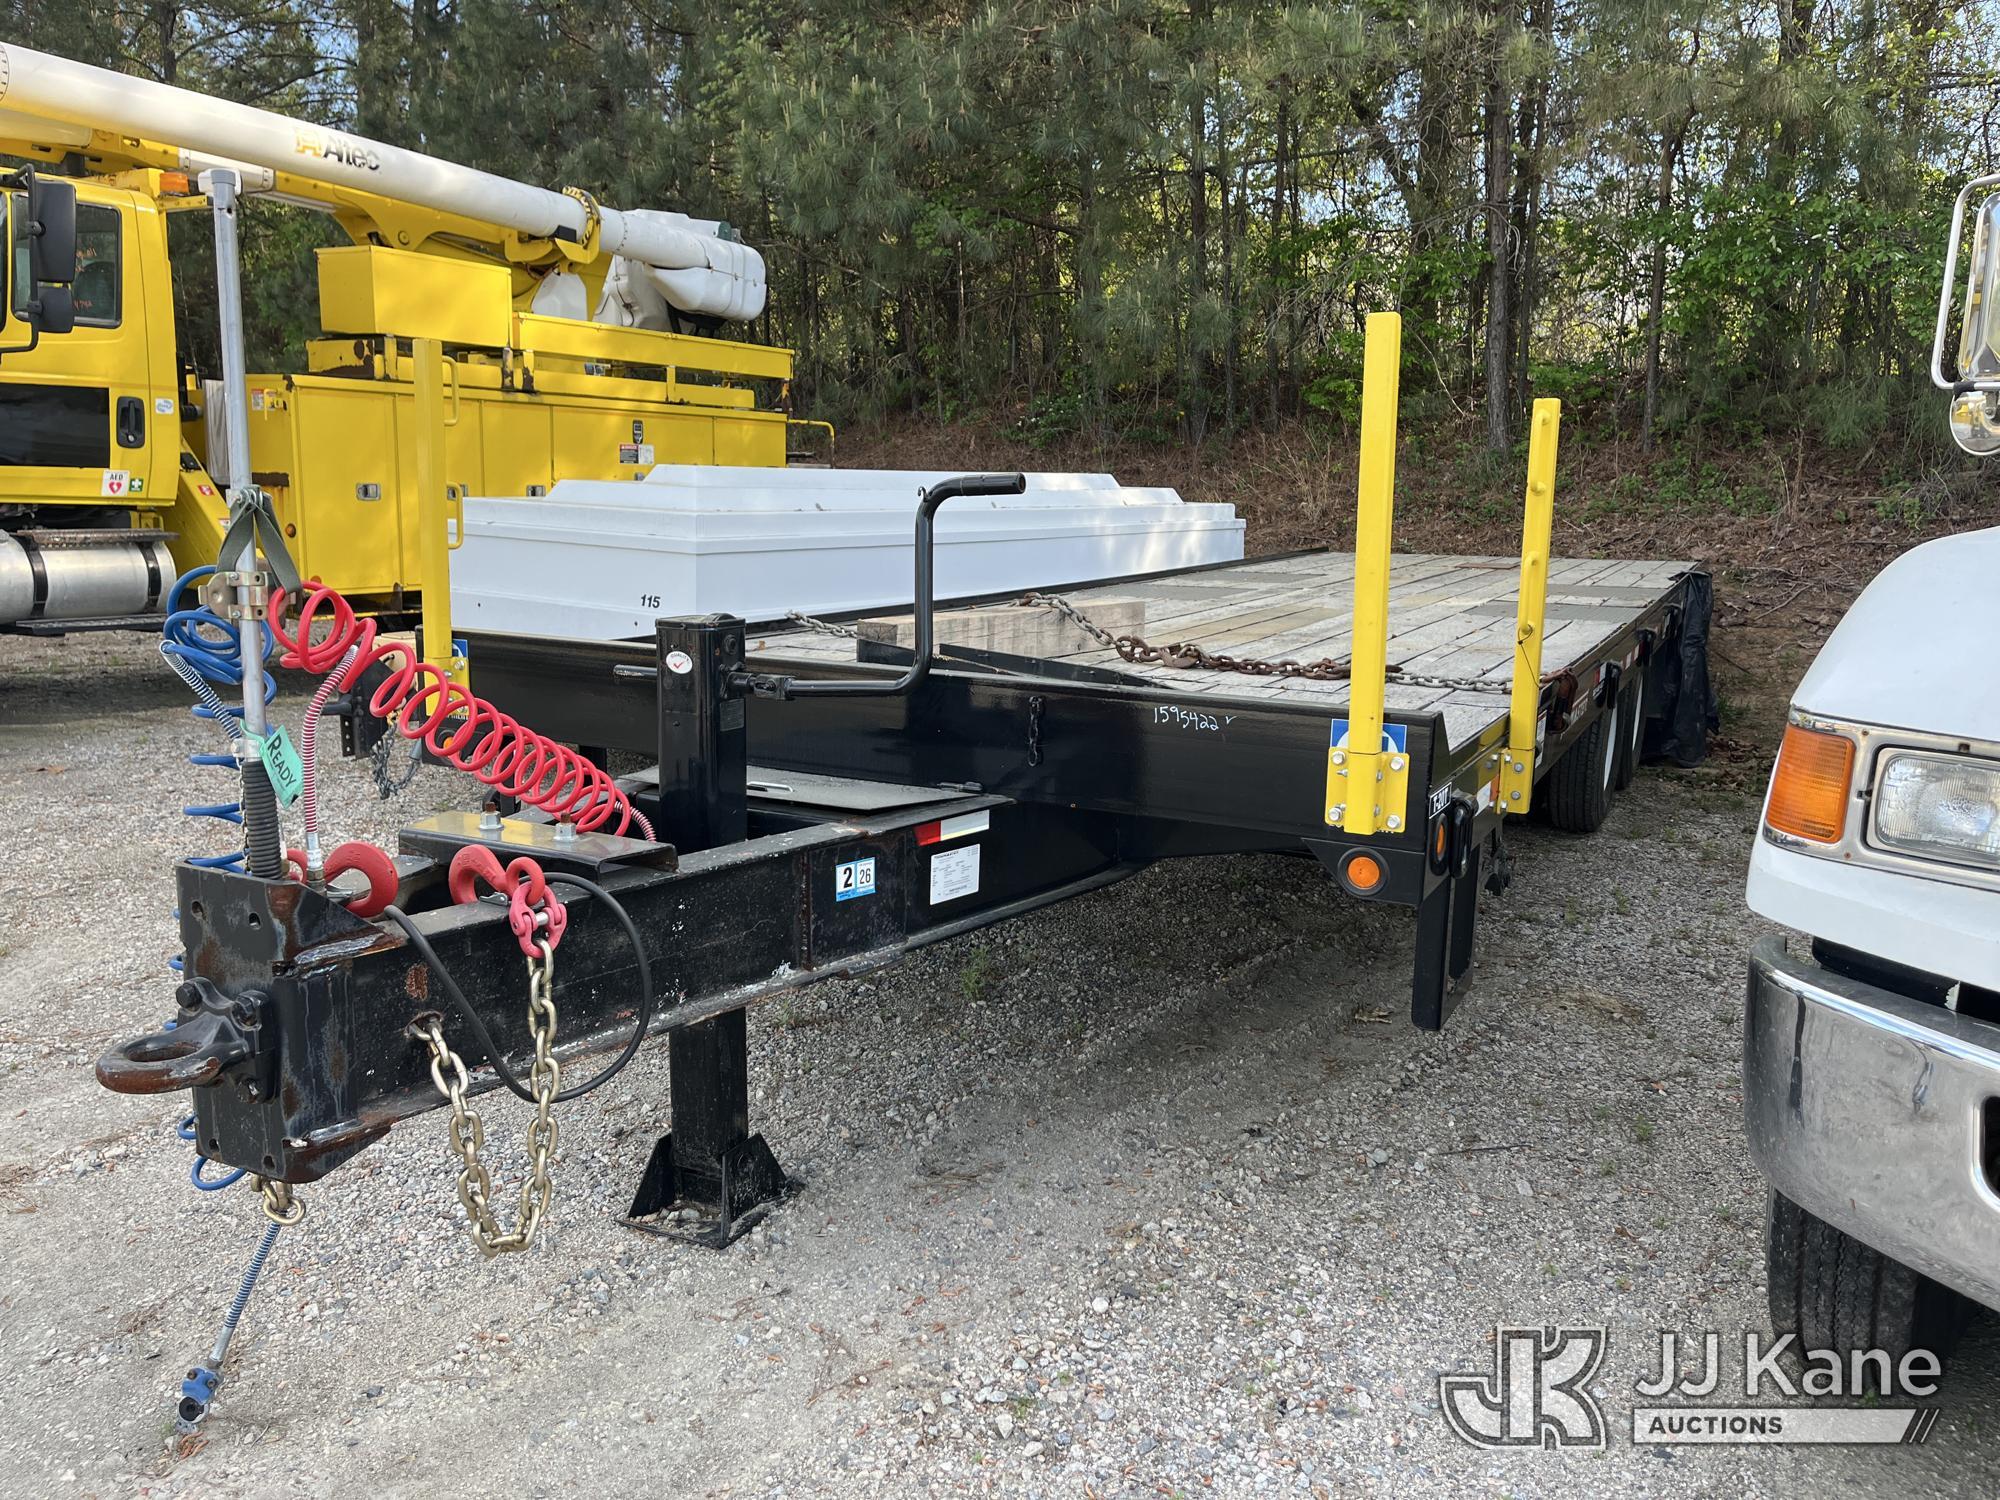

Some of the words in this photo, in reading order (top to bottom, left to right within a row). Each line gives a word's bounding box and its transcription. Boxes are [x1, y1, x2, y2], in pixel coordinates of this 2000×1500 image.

[110, 473, 124, 481] AED
[641, 594, 661, 609] 115
[1154, 706, 1220, 731] 1595422
[267, 734, 297, 788] READY
[843, 866, 853, 889] 2
[859, 868, 871, 885] 26
